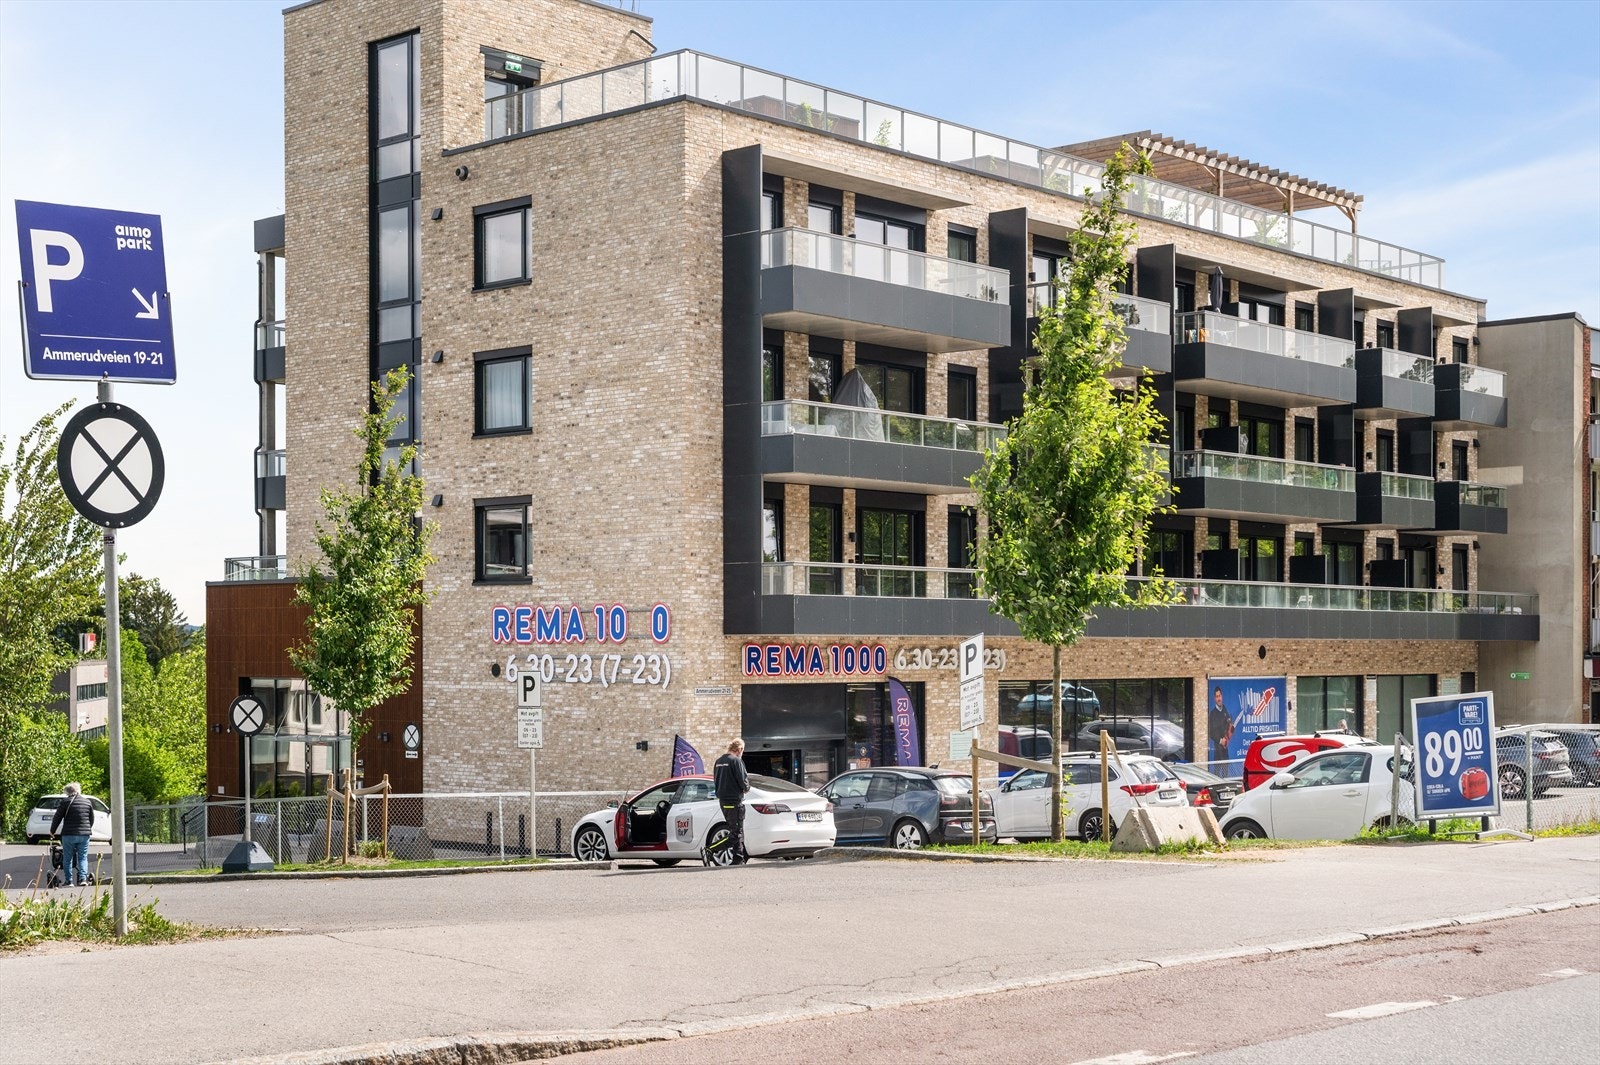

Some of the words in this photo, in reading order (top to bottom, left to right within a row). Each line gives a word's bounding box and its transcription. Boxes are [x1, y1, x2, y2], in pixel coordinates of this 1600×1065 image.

[115, 225, 152, 239] aimo
[116, 236, 153, 251] park
[30, 228, 84, 313] P
[42, 347, 131, 363] Ammerudveien
[133, 351, 163, 365] 19-21
[491, 603, 587, 645] REMA
[599, 653, 672, 690] (7-23)
[743, 643, 825, 677] REMA
[827, 643, 888, 677] 1000
[966, 643, 978, 676] P
[522, 675, 536, 703] P
[1424, 729, 1463, 778] 89
[677, 818, 689, 828] Taxi
